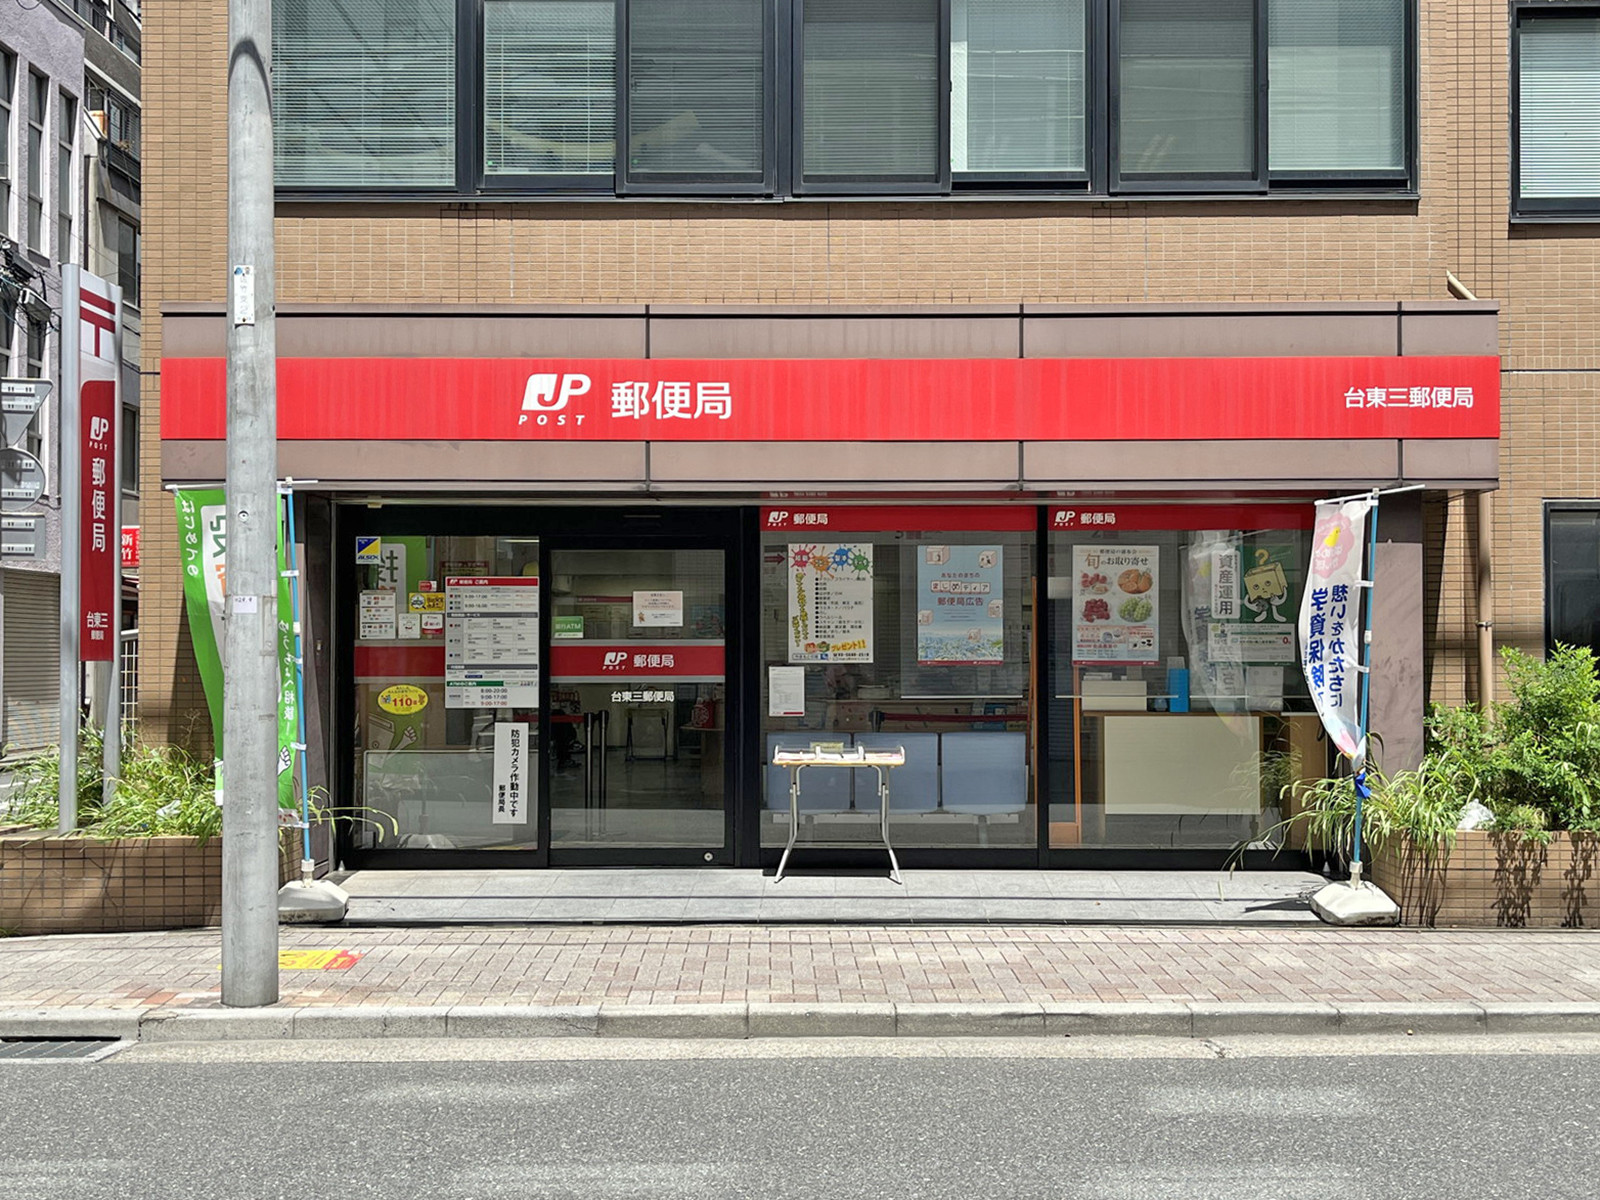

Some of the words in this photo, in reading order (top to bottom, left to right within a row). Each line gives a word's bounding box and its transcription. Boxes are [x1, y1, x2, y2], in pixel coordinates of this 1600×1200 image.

[521, 373, 592, 411] JP
[611, 380, 732, 420] 郵便局
[1344, 386, 1474, 409] 台東三郵便局
[90, 416, 109, 441] JP
[518, 414, 585, 426] POST
[88, 440, 108, 452] POST
[91, 457, 106, 552] 郵便局
[768, 511, 789, 523] JP
[793, 513, 829, 525] 郵便局
[1055, 511, 1076, 523] JP
[1080, 512, 1117, 525] 郵便局
[1085, 553, 1149, 570] 旬のお取り寄せ
[1218, 554, 1234, 615] 資産運用
[86, 611, 108, 629] 台東三
[604, 651, 628, 666] JP
[633, 655, 675, 668] 郵便局
[611, 691, 675, 702] 台東三郵便局
[510, 729, 520, 818] 防犯カメラ作動中です
[498, 784, 506, 813] 郵便局長
